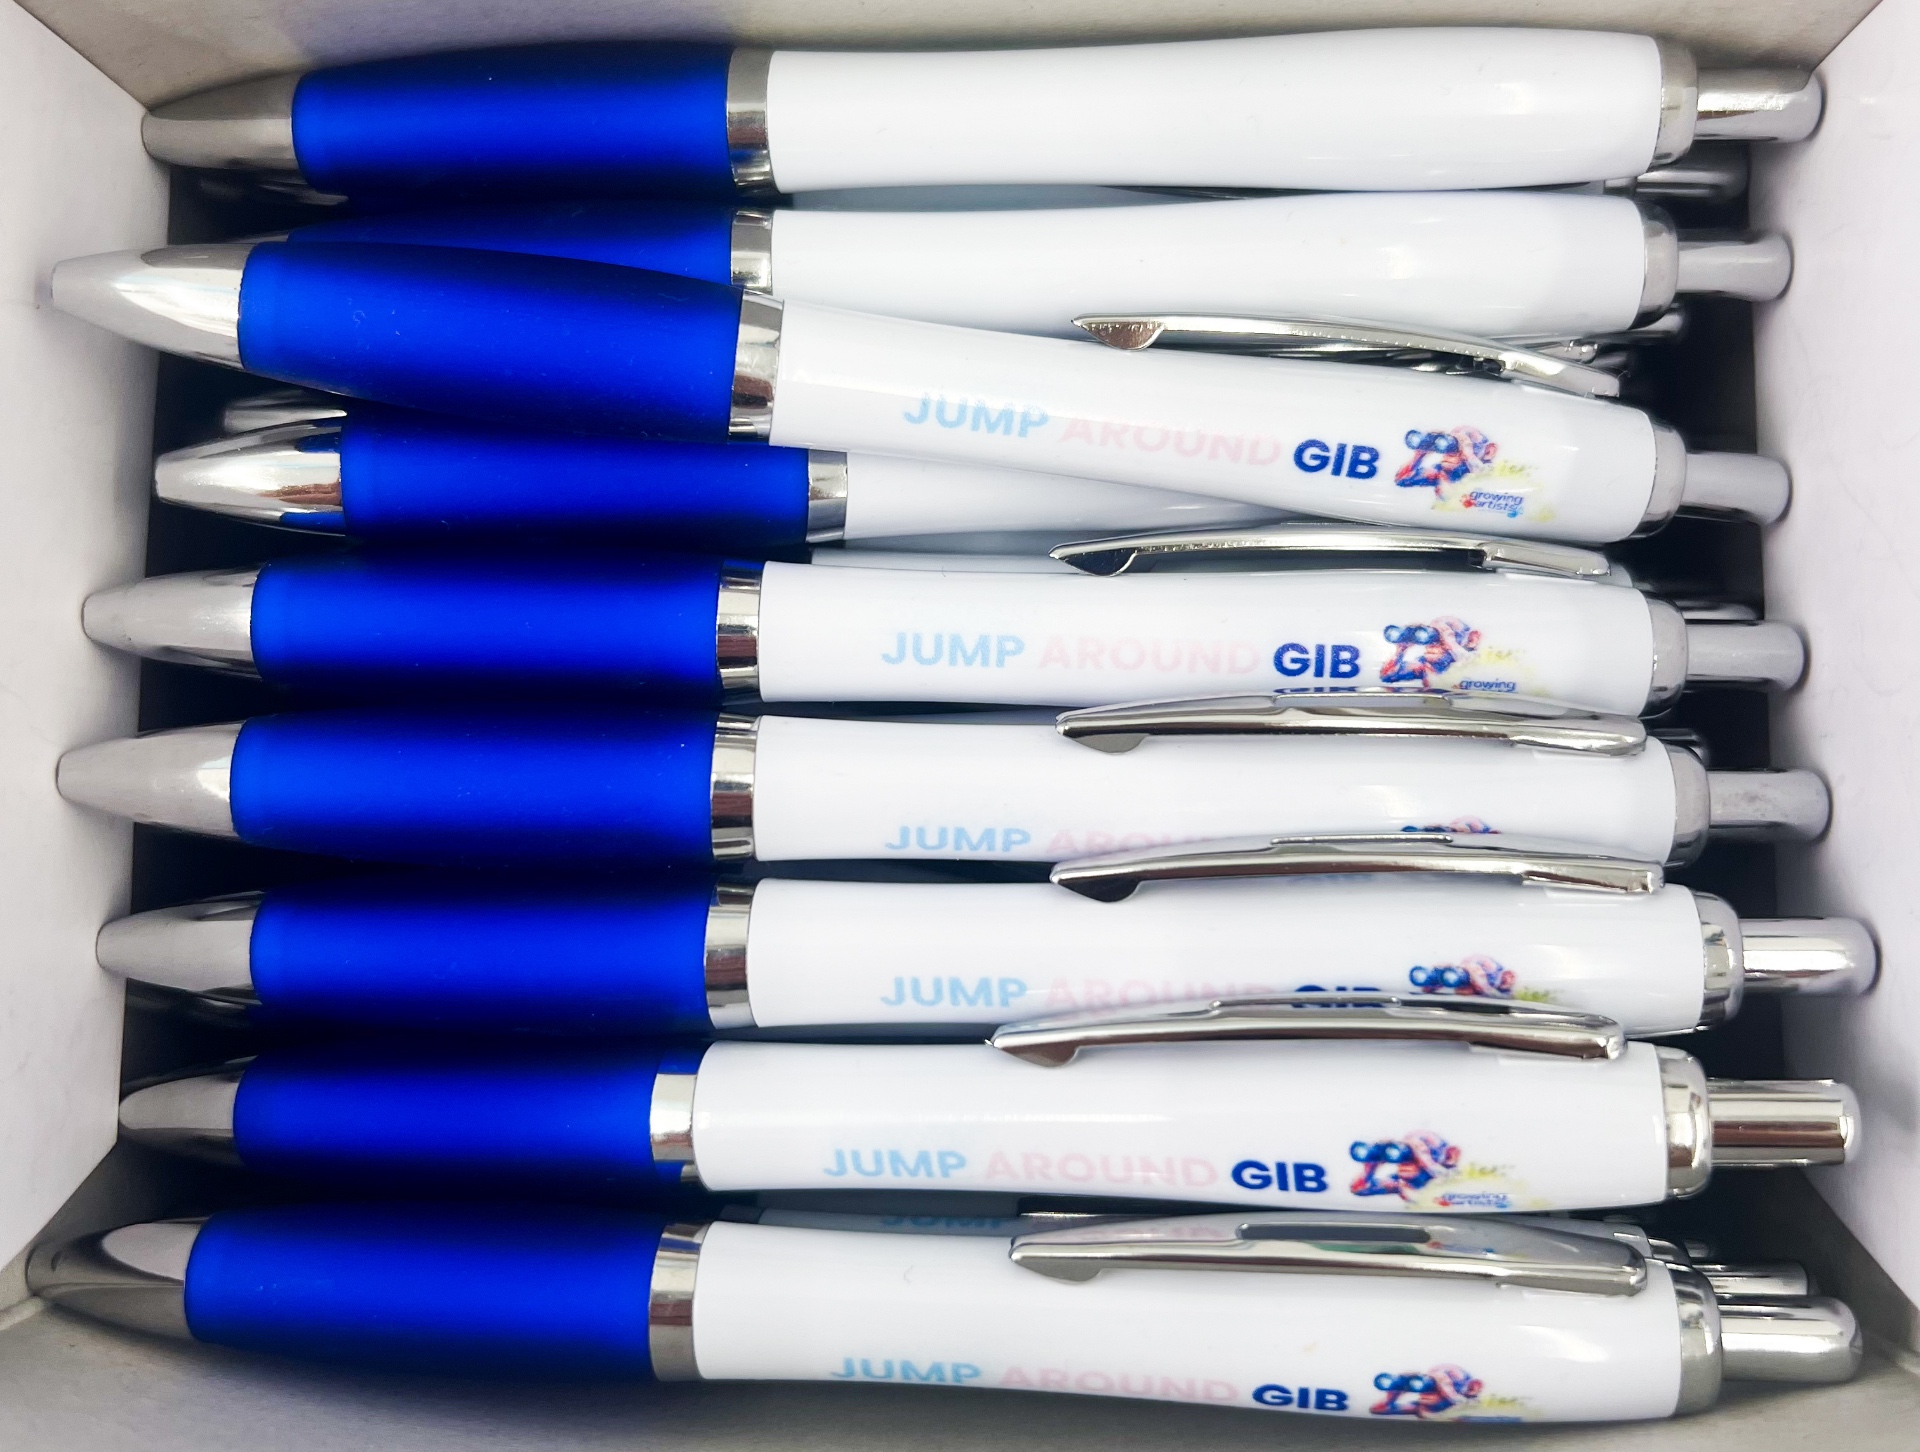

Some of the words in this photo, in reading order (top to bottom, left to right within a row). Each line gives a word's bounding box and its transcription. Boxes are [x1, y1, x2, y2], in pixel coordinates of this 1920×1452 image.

[903, 393, 1050, 439] JUMP
[1061, 412, 1281, 466] AROUND
[1292, 438, 1380, 481] GIB
[1470, 490, 1524, 506] growing
[881, 632, 1025, 669] JUMP
[1040, 638, 1260, 675] AROUND
[1273, 642, 1361, 679] GIB
[885, 824, 1032, 853] JUMP
[881, 975, 1028, 1008] JUMP
[823, 1147, 968, 1180] JUMP
[985, 1152, 1218, 1188] AROUND
[1231, 1158, 1330, 1195] GIB
[832, 1356, 983, 1385] JUMP
[1001, 1366, 1240, 1403] AROUND
[1251, 1383, 1349, 1412] GIB
